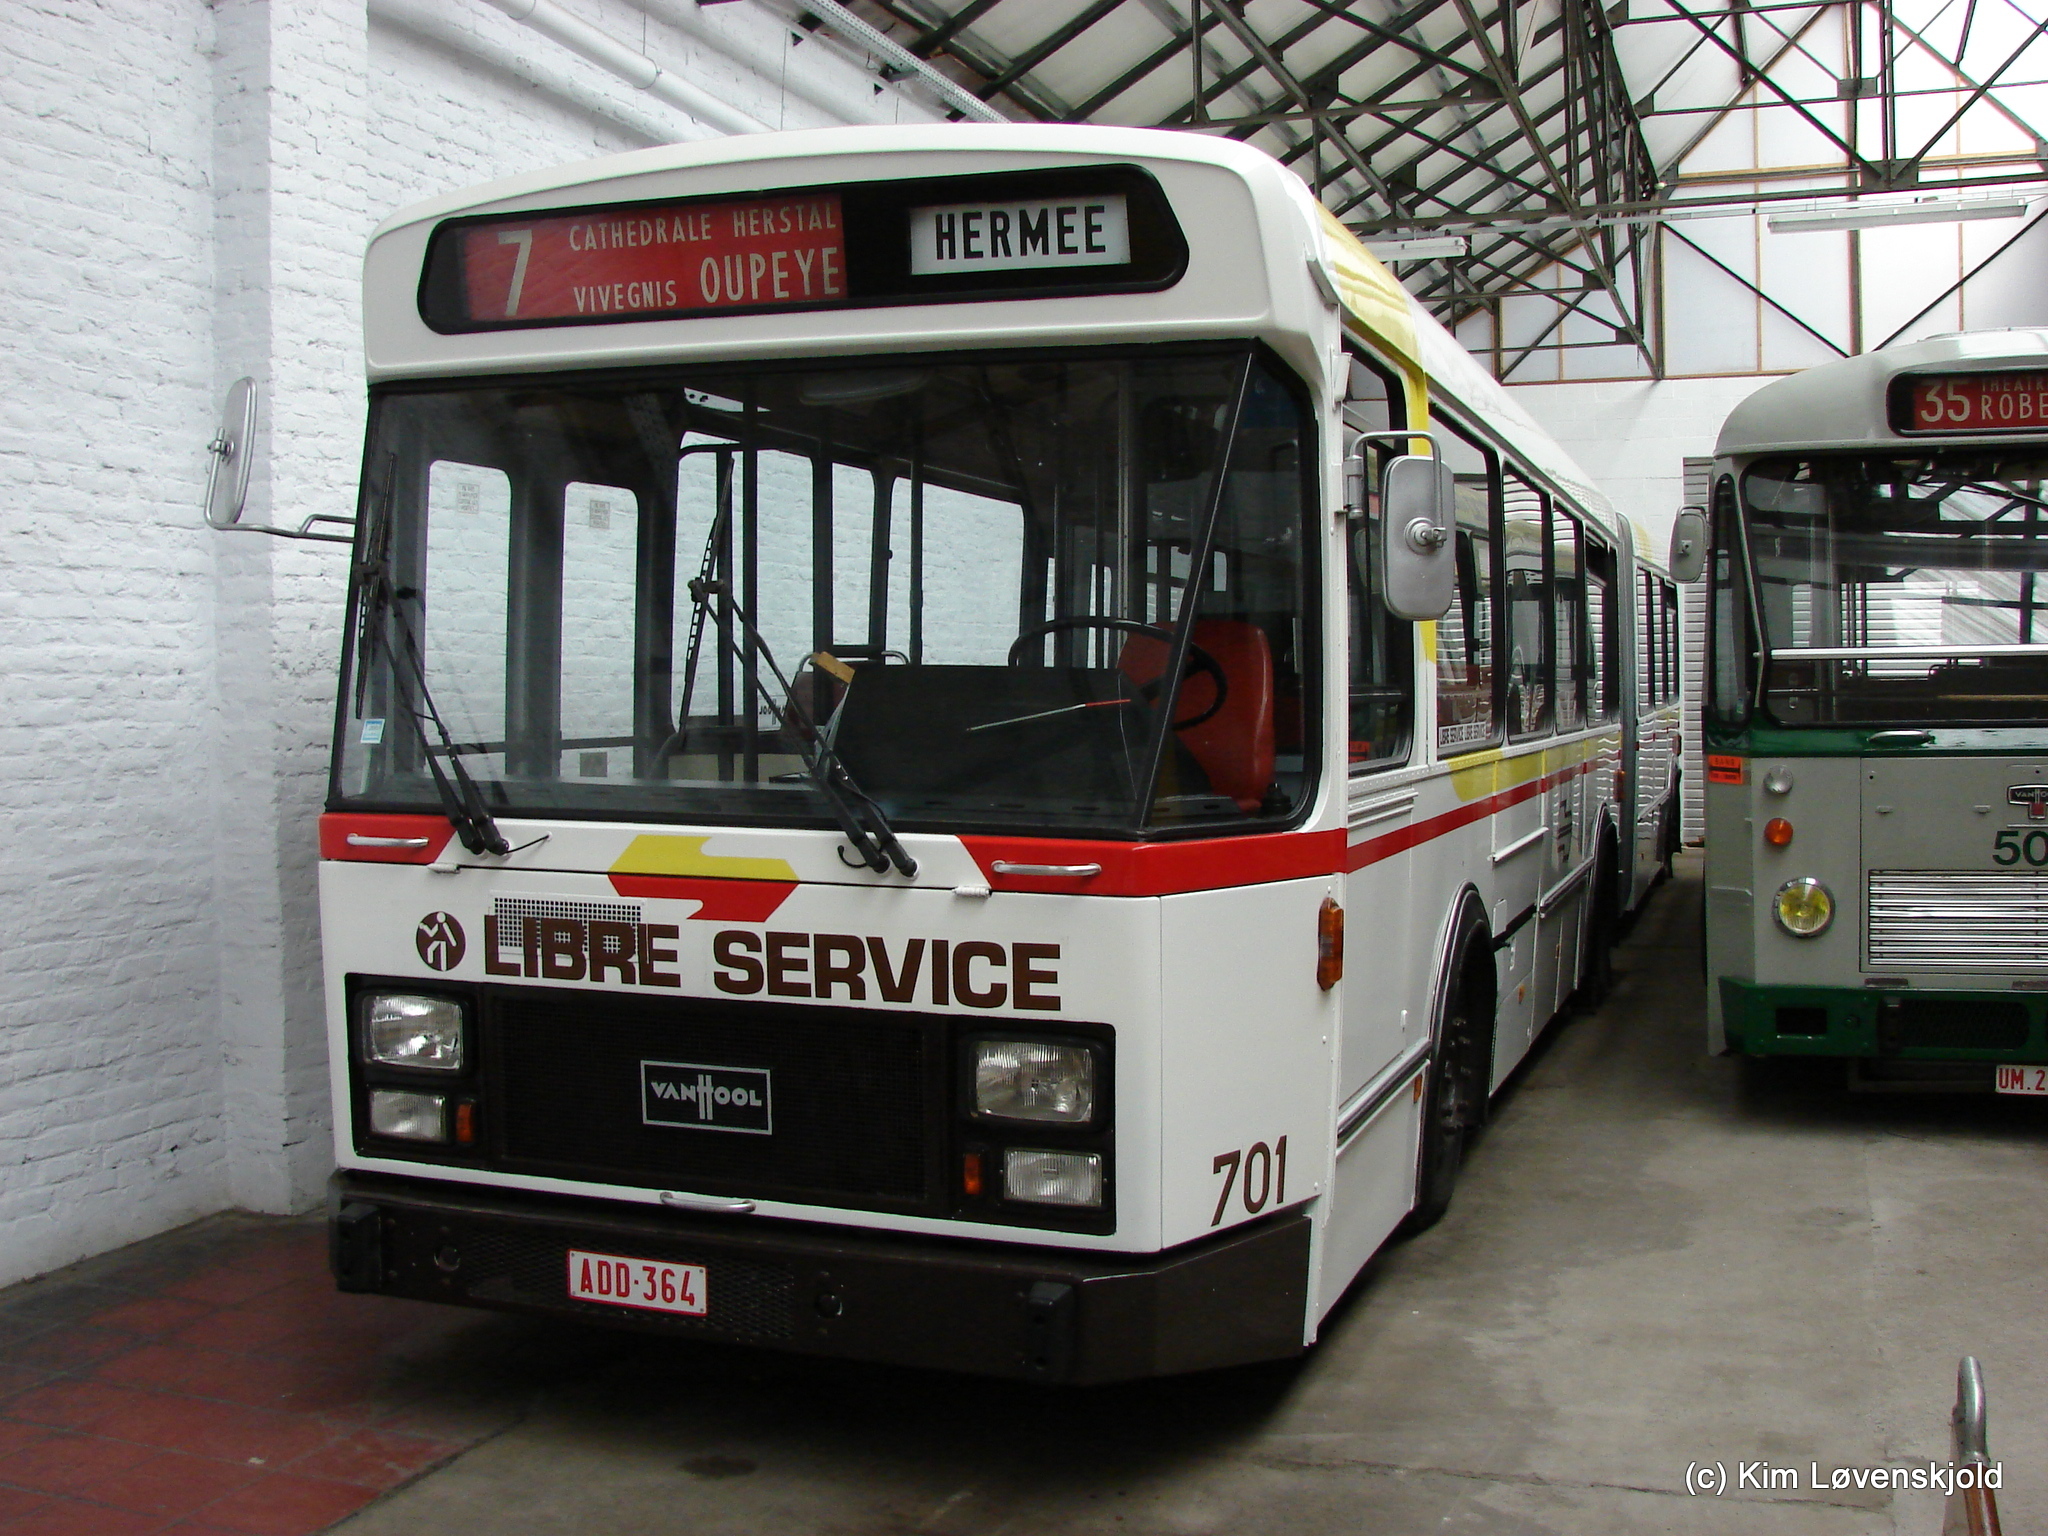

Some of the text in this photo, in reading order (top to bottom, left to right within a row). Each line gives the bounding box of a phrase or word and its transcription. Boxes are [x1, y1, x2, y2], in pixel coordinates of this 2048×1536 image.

[569, 203, 837, 251] CATHEDRALE HERSTAL
[935, 205, 1106, 260] HERMEE
[497, 229, 533, 317] 7
[573, 247, 840, 313] VIVEGNIS OUPEYE
[1920, 379, 1971, 422] 35
[1981, 376, 2048, 392] THEATR
[1981, 393, 2048, 420] ROBE
[2015, 788, 2048, 804] VANHO
[1992, 830, 2048, 866] 50
[484, 914, 1061, 1011] LIBRE SERVICE
[1210, 1135, 1287, 1227] 701
